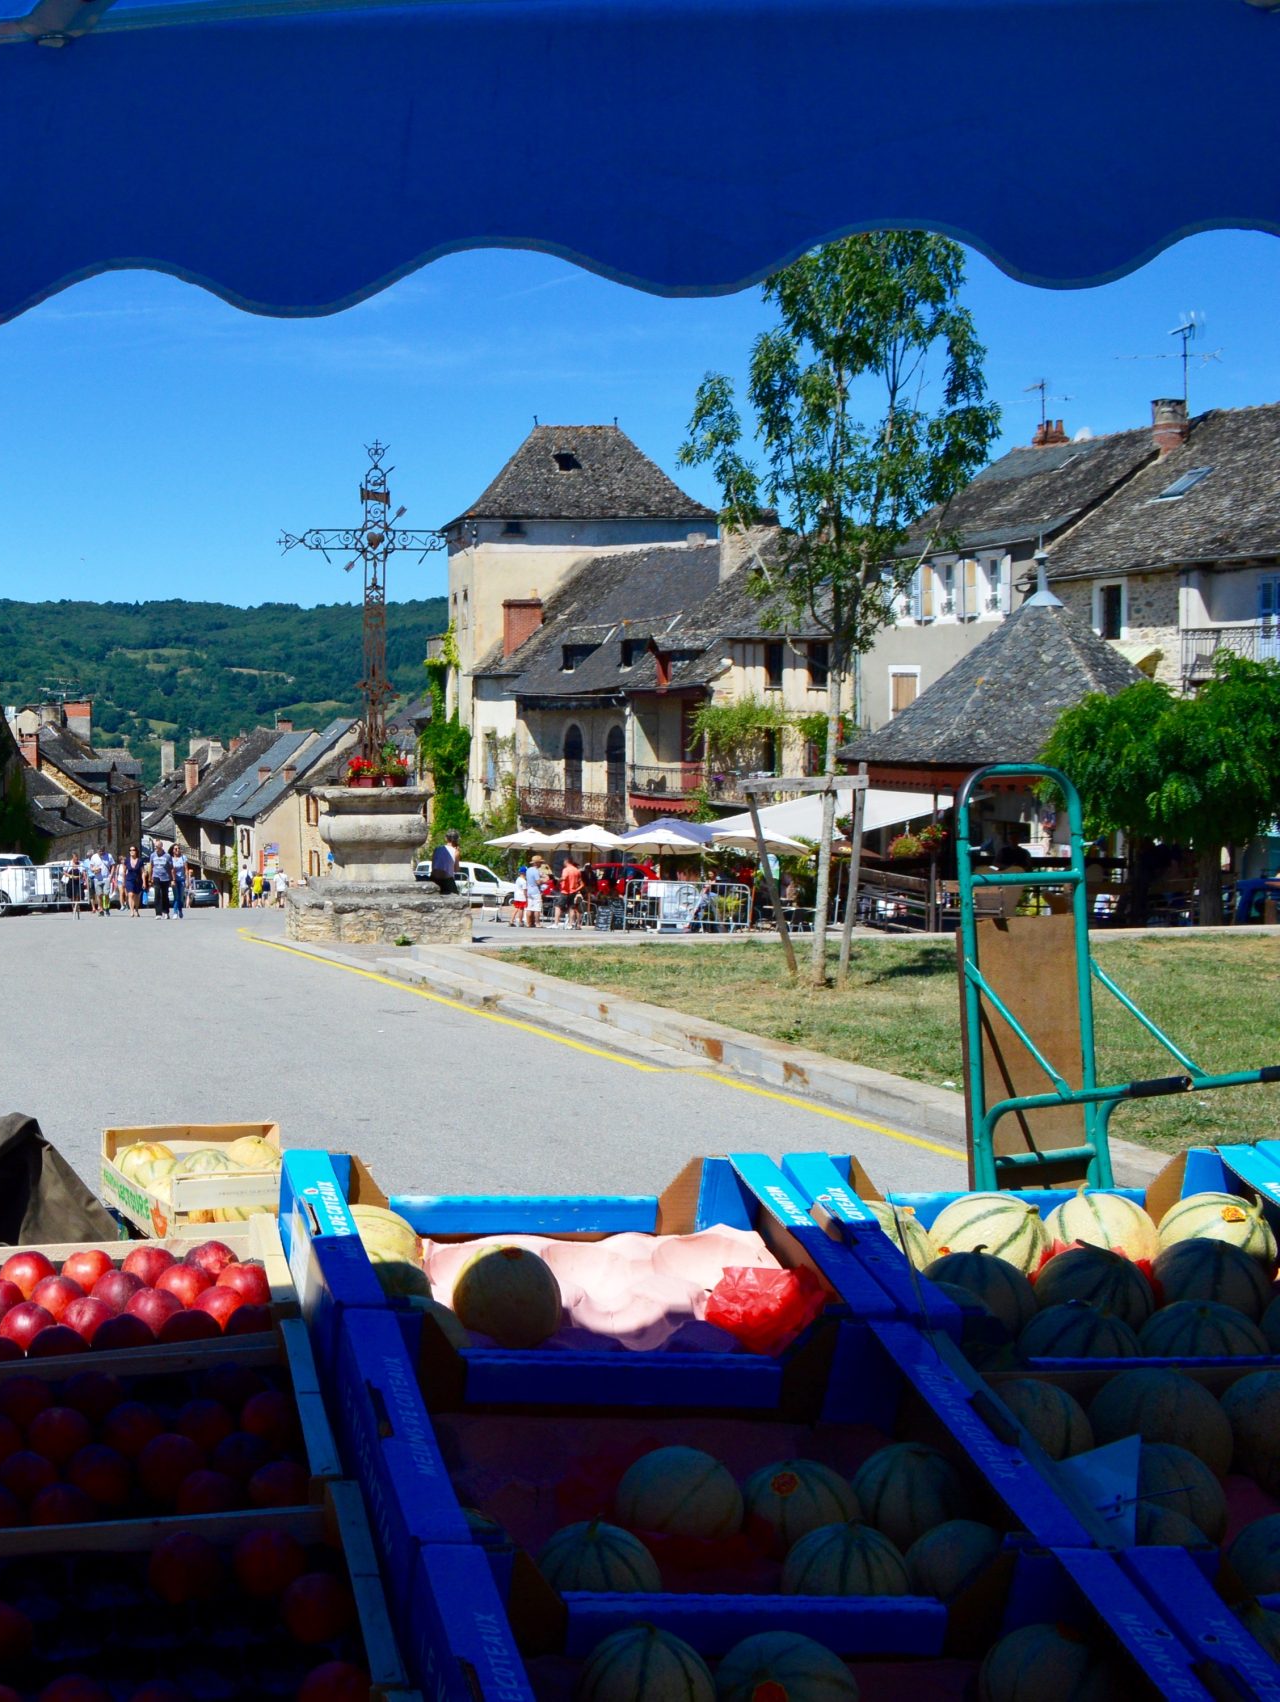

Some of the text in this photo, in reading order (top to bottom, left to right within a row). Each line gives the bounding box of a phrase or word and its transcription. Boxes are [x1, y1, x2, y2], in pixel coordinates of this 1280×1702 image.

[317, 1180, 345, 1215] COTEAUX
[329, 1213, 349, 1229] DE
[764, 1185, 800, 1217] MELONS
[381, 1355, 416, 1408] COTEAUX
[397, 1408, 421, 1427] DE
[912, 1364, 1021, 1480] MELONS DE COTEAUX
[405, 1425, 440, 1478] MELONS
[472, 1611, 520, 1689] COTEAUX
[1113, 1611, 1204, 1700] MELONS DE
[1204, 1616, 1280, 1692] COTEAUX
